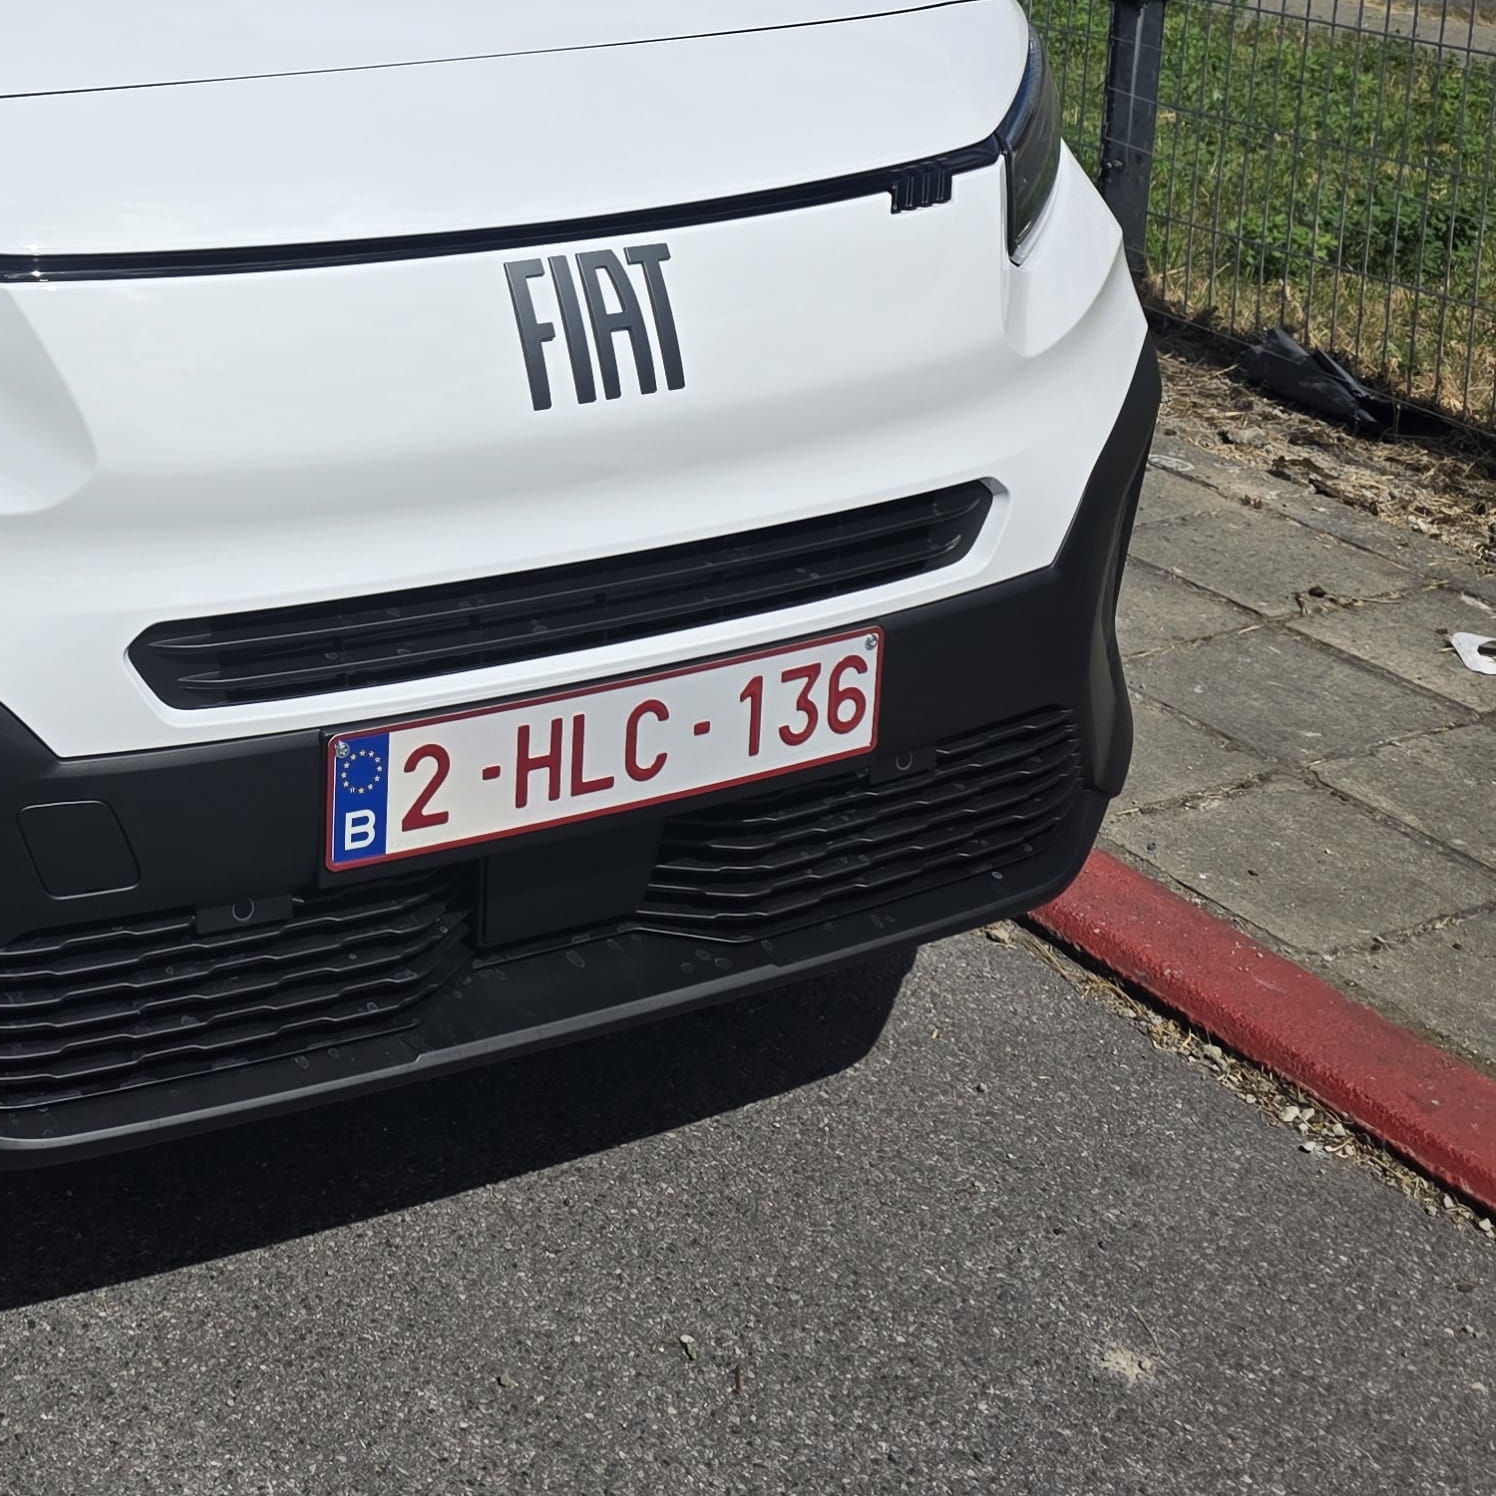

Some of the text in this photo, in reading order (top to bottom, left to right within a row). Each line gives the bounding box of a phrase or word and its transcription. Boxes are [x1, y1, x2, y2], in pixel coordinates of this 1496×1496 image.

[503, 243, 686, 411] FIAT
[401, 654, 869, 832] 2-HLC-136
[344, 809, 376, 851] B
